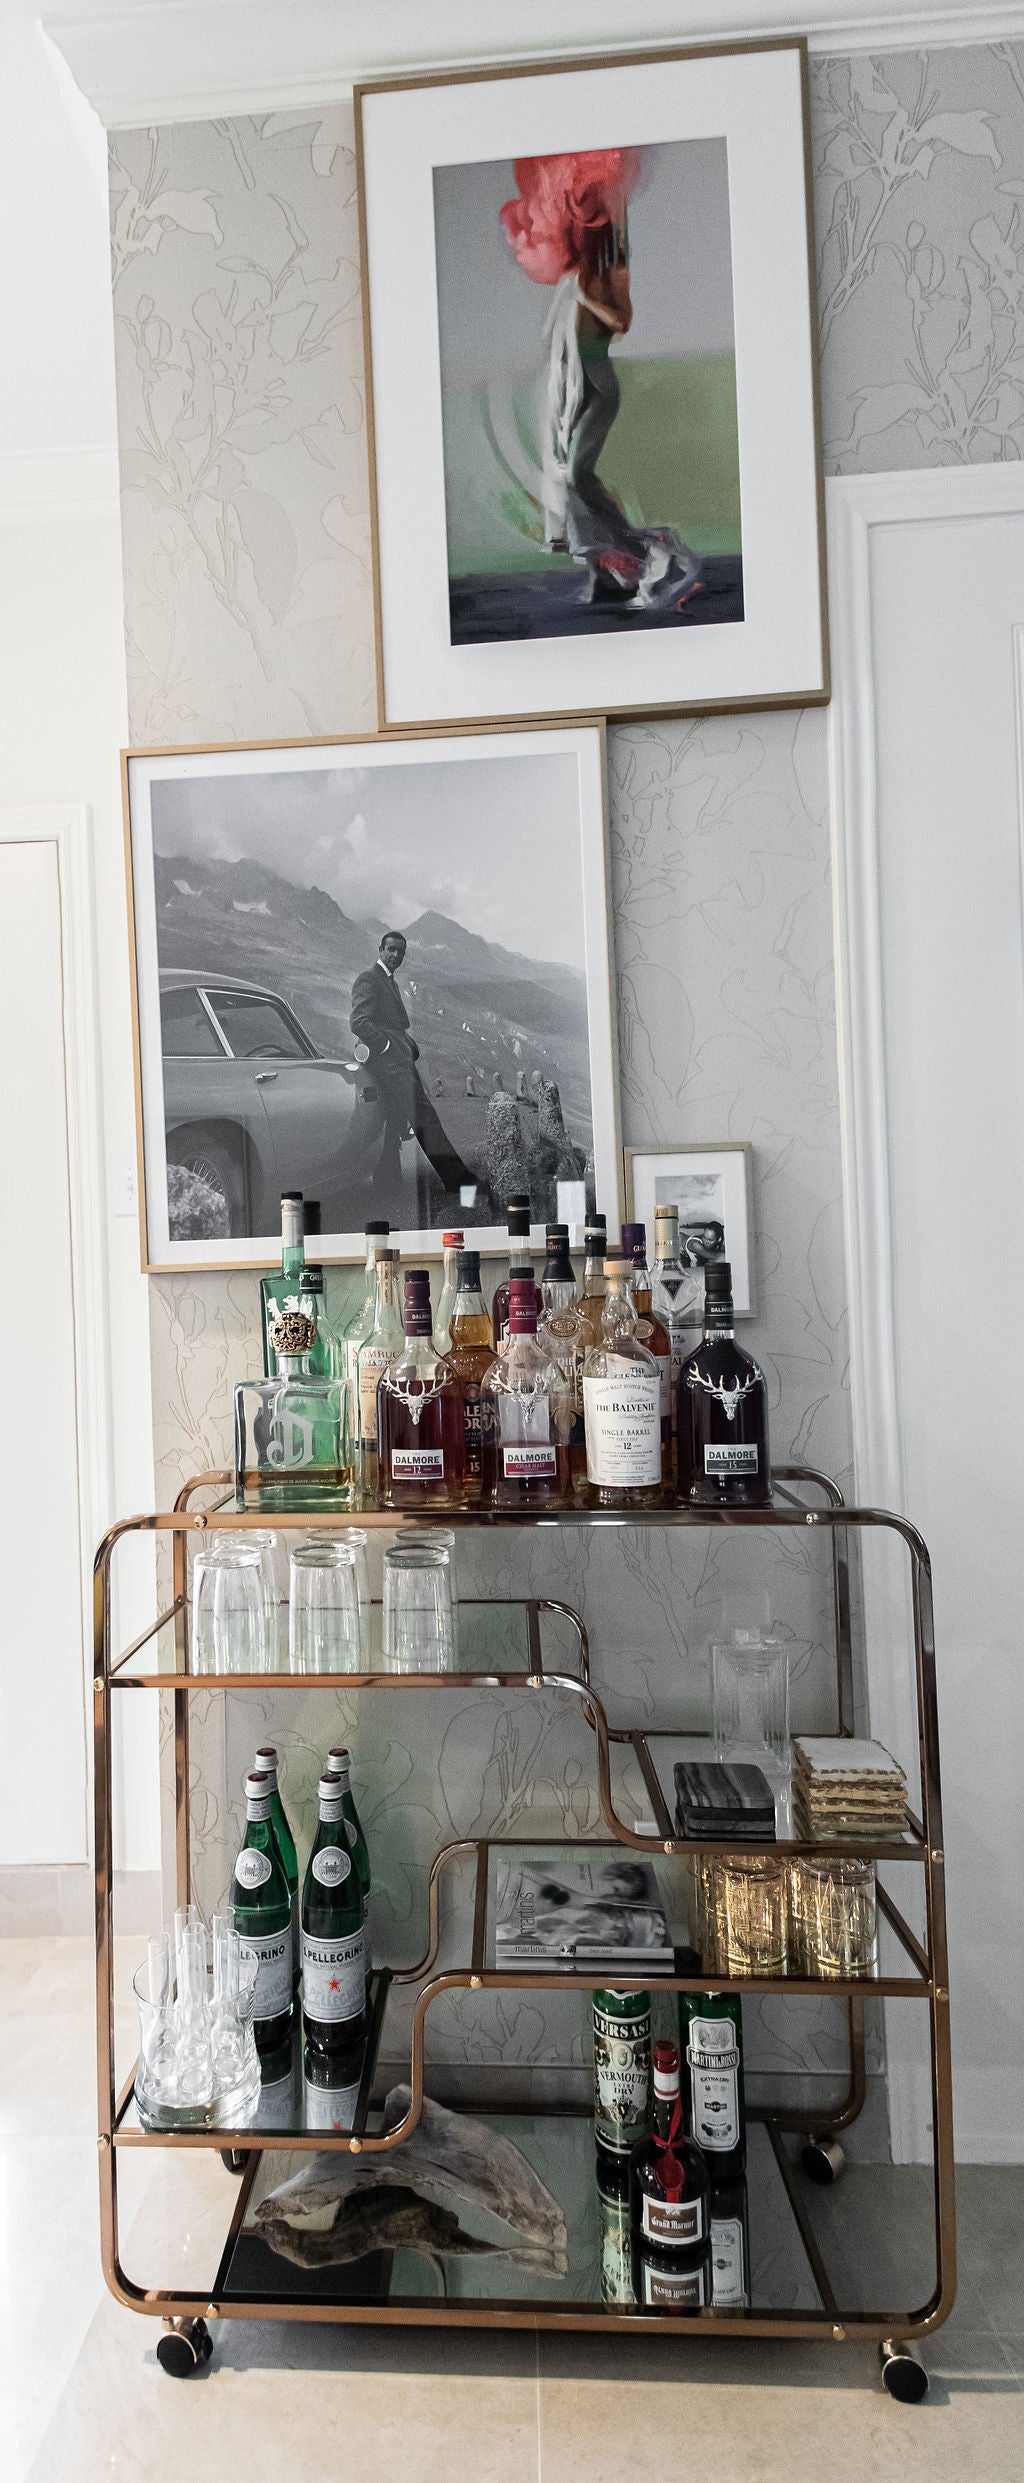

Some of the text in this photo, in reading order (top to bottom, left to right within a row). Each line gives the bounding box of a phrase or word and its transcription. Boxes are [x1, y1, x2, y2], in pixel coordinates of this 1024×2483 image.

[352, 1344, 400, 1359] SAMBUC
[596, 1403, 655, 1412] THE BALVENIE
[601, 1429, 625, 1437] SINGLE
[395, 1455, 440, 1464] DALMORE
[507, 1453, 553, 1462] DALMORE
[708, 1450, 755, 1460] DALMORE
[413, 1465, 422, 1474] 12
[470, 1462, 480, 1472] 15
[728, 1461, 737, 1469] 15
[515, 1945, 547, 1953] martinis
[599, 2071, 648, 2086] VERMOUTH
[651, 2216, 694, 2229] Grand Marnier
